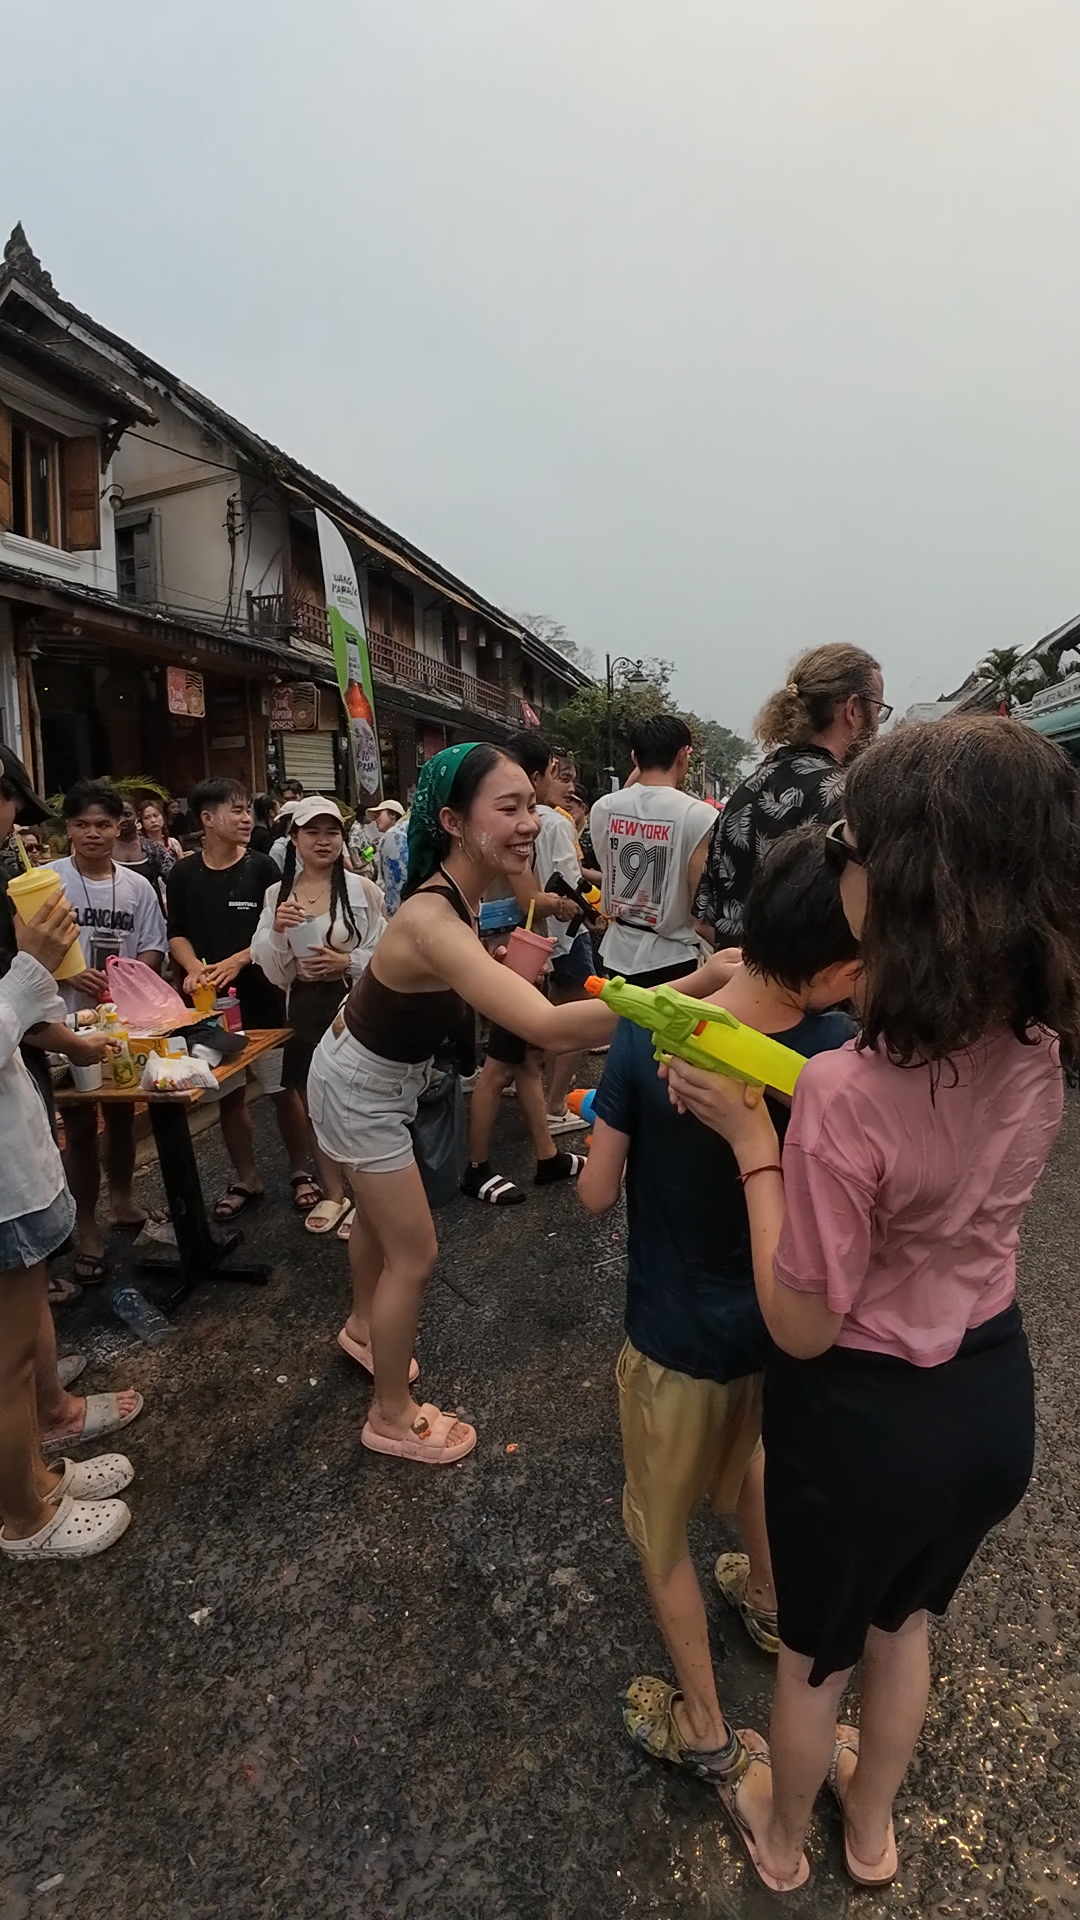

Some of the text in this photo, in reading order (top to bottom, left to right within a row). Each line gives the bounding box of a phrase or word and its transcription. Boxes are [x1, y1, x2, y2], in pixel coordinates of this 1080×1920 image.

[611, 819, 670, 841] NEW YORK
[610, 838, 619, 850] 19
[620, 841, 667, 905] 91
